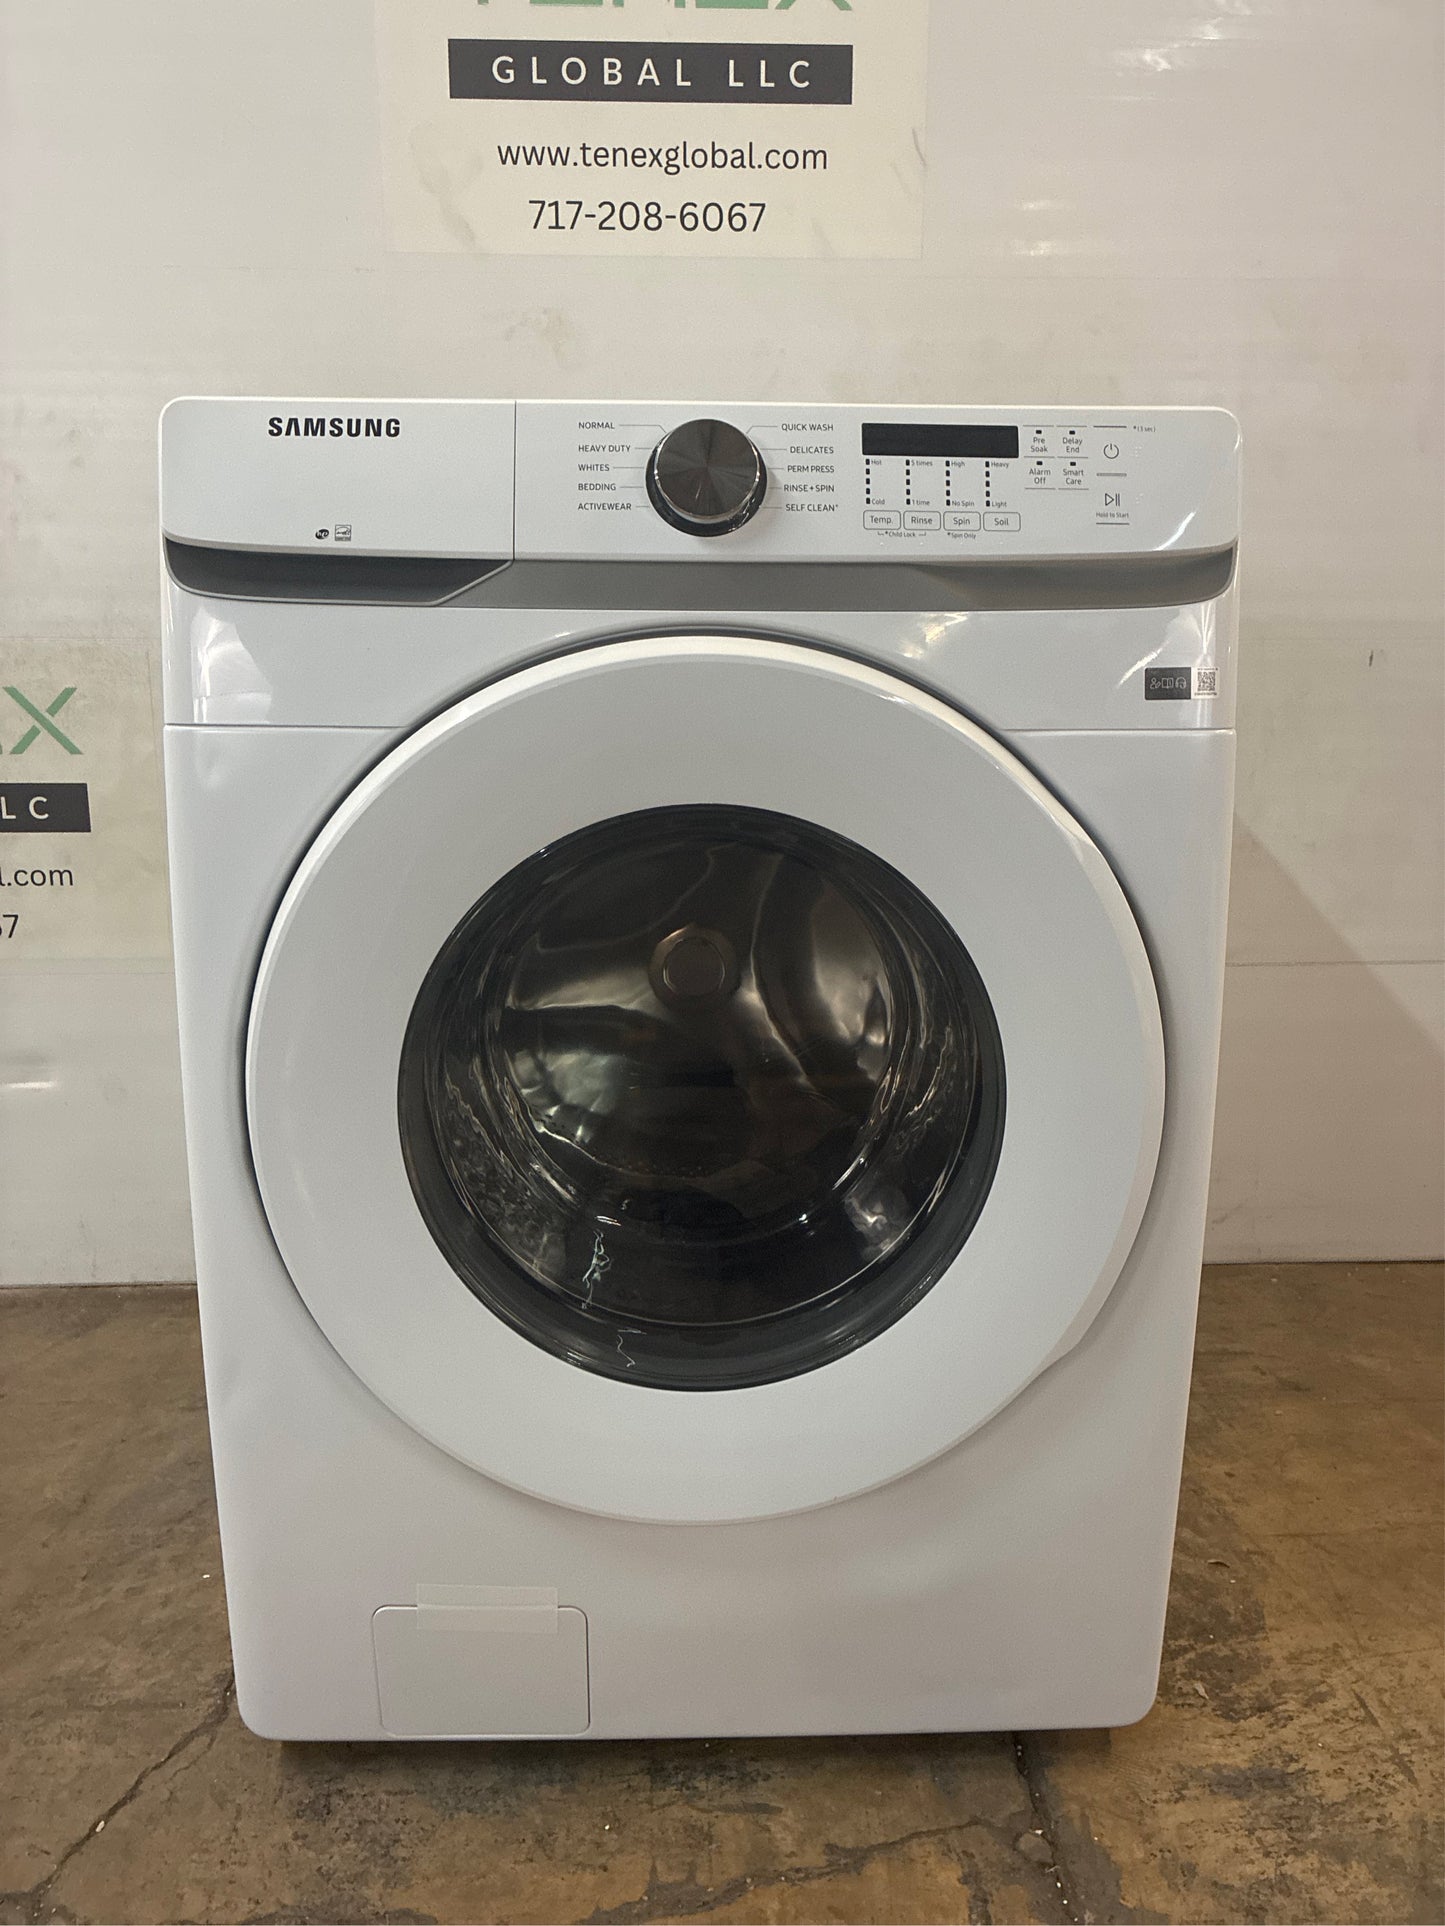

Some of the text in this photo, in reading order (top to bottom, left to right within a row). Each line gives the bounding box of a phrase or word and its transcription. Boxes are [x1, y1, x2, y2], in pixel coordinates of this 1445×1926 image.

[492, 55, 811, 89] GLOBAL LLC
[497, 142, 828, 176] www.tenexglobal.com
[528, 200, 766, 233] 717-208-6067
[268, 417, 400, 437] SAMSUNG
[578, 421, 615, 430] NORMAL
[781, 423, 834, 432] QUICK WASH
[1062, 437, 1083, 446] Delay
[578, 444, 631, 453] HEAVY DUTY
[789, 446, 834, 454] DELICATES
[1030, 445, 1048, 453] Soak
[578, 464, 610, 472] WHITES
[951, 460, 965, 468] High
[991, 461, 1009, 469] Heavy
[787, 465, 835, 473] PERM PRESS
[1029, 468, 1051, 476] Alarm
[1034, 477, 1046, 485] Off
[578, 483, 617, 491] BEDDING
[784, 484, 808, 492] RINSE
[815, 484, 835, 492] SPIN
[578, 503, 632, 511] ACTIVEWEAR
[785, 504, 807, 512] SELF
[961, 500, 975, 508] Spin
[870, 515, 893, 525] Temp.
[911, 516, 933, 524] Rinse
[953, 517, 971, 526] Spin
[994, 517, 1009, 526] Soil
[0, 796, 49, 820] LC
